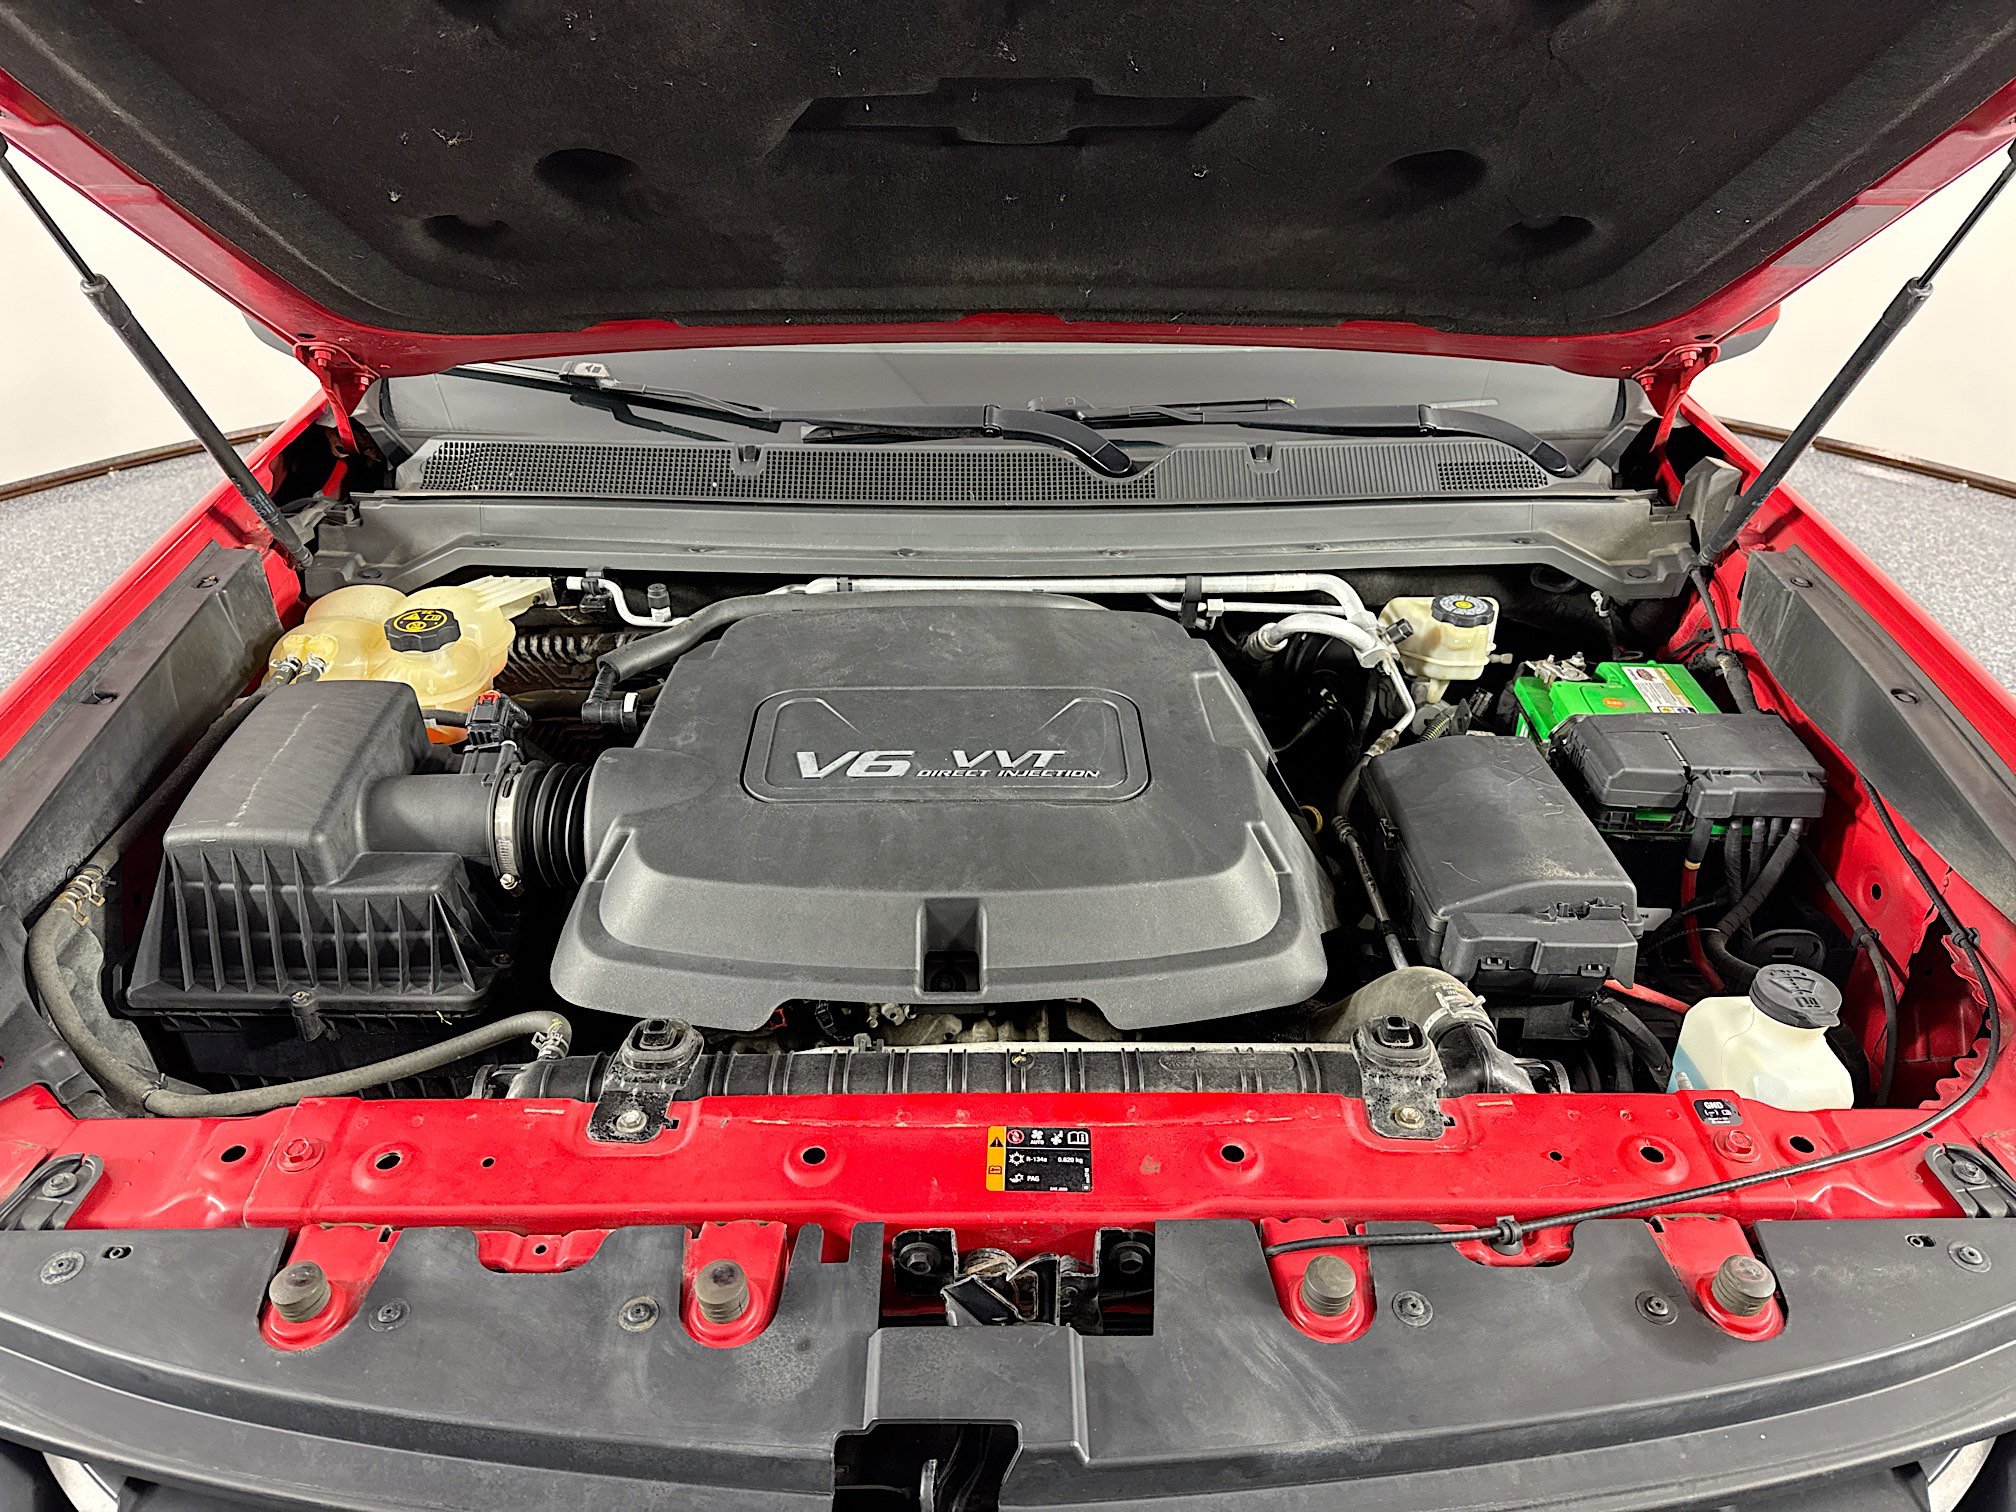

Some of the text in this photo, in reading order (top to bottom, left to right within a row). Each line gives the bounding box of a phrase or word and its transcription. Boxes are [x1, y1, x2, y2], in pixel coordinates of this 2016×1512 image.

[796, 750, 1067, 779] V6 VVT
[916, 769, 1101, 779] DIRECT INJECTION
[1703, 1101, 1724, 1110] GND
